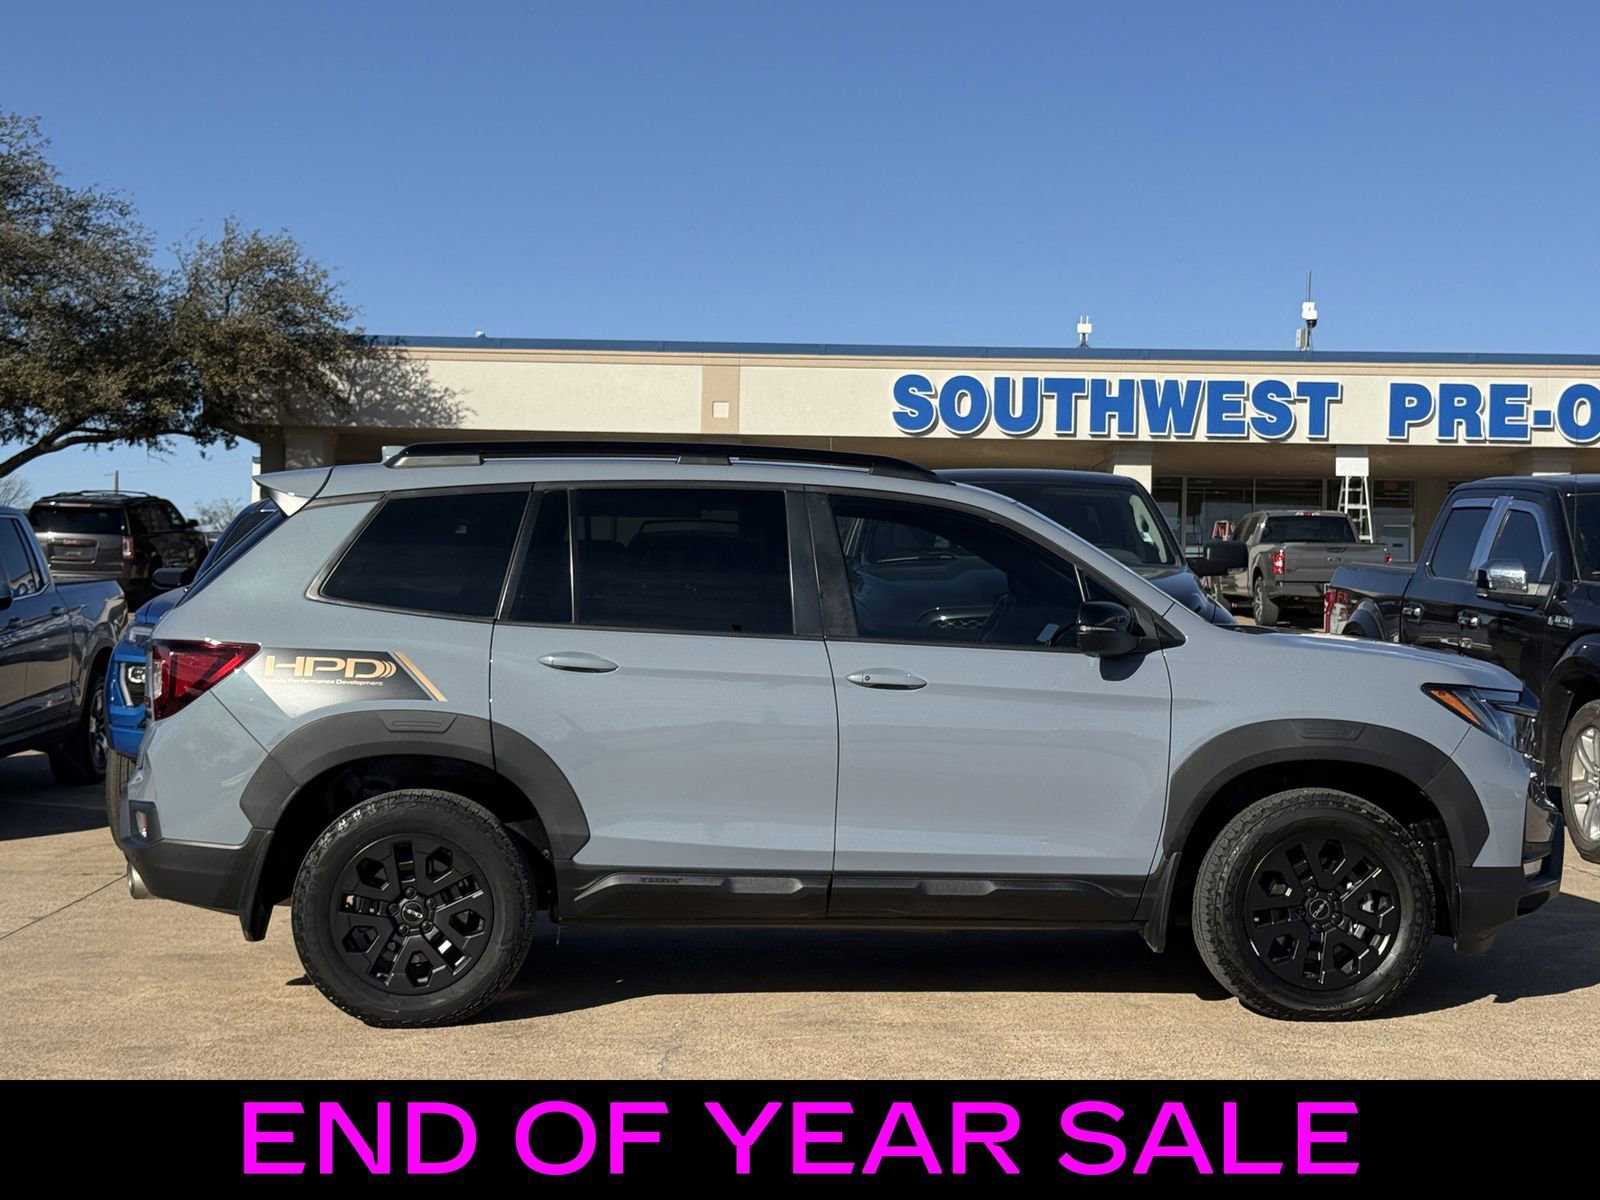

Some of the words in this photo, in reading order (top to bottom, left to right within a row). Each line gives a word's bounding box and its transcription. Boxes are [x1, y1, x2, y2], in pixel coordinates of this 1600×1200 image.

[893, 373, 1339, 438] SOUTHWEST
[1387, 382, 1600, 440] PRE-O
[264, 655, 396, 679] HPD
[336, 679, 384, 687] Development
